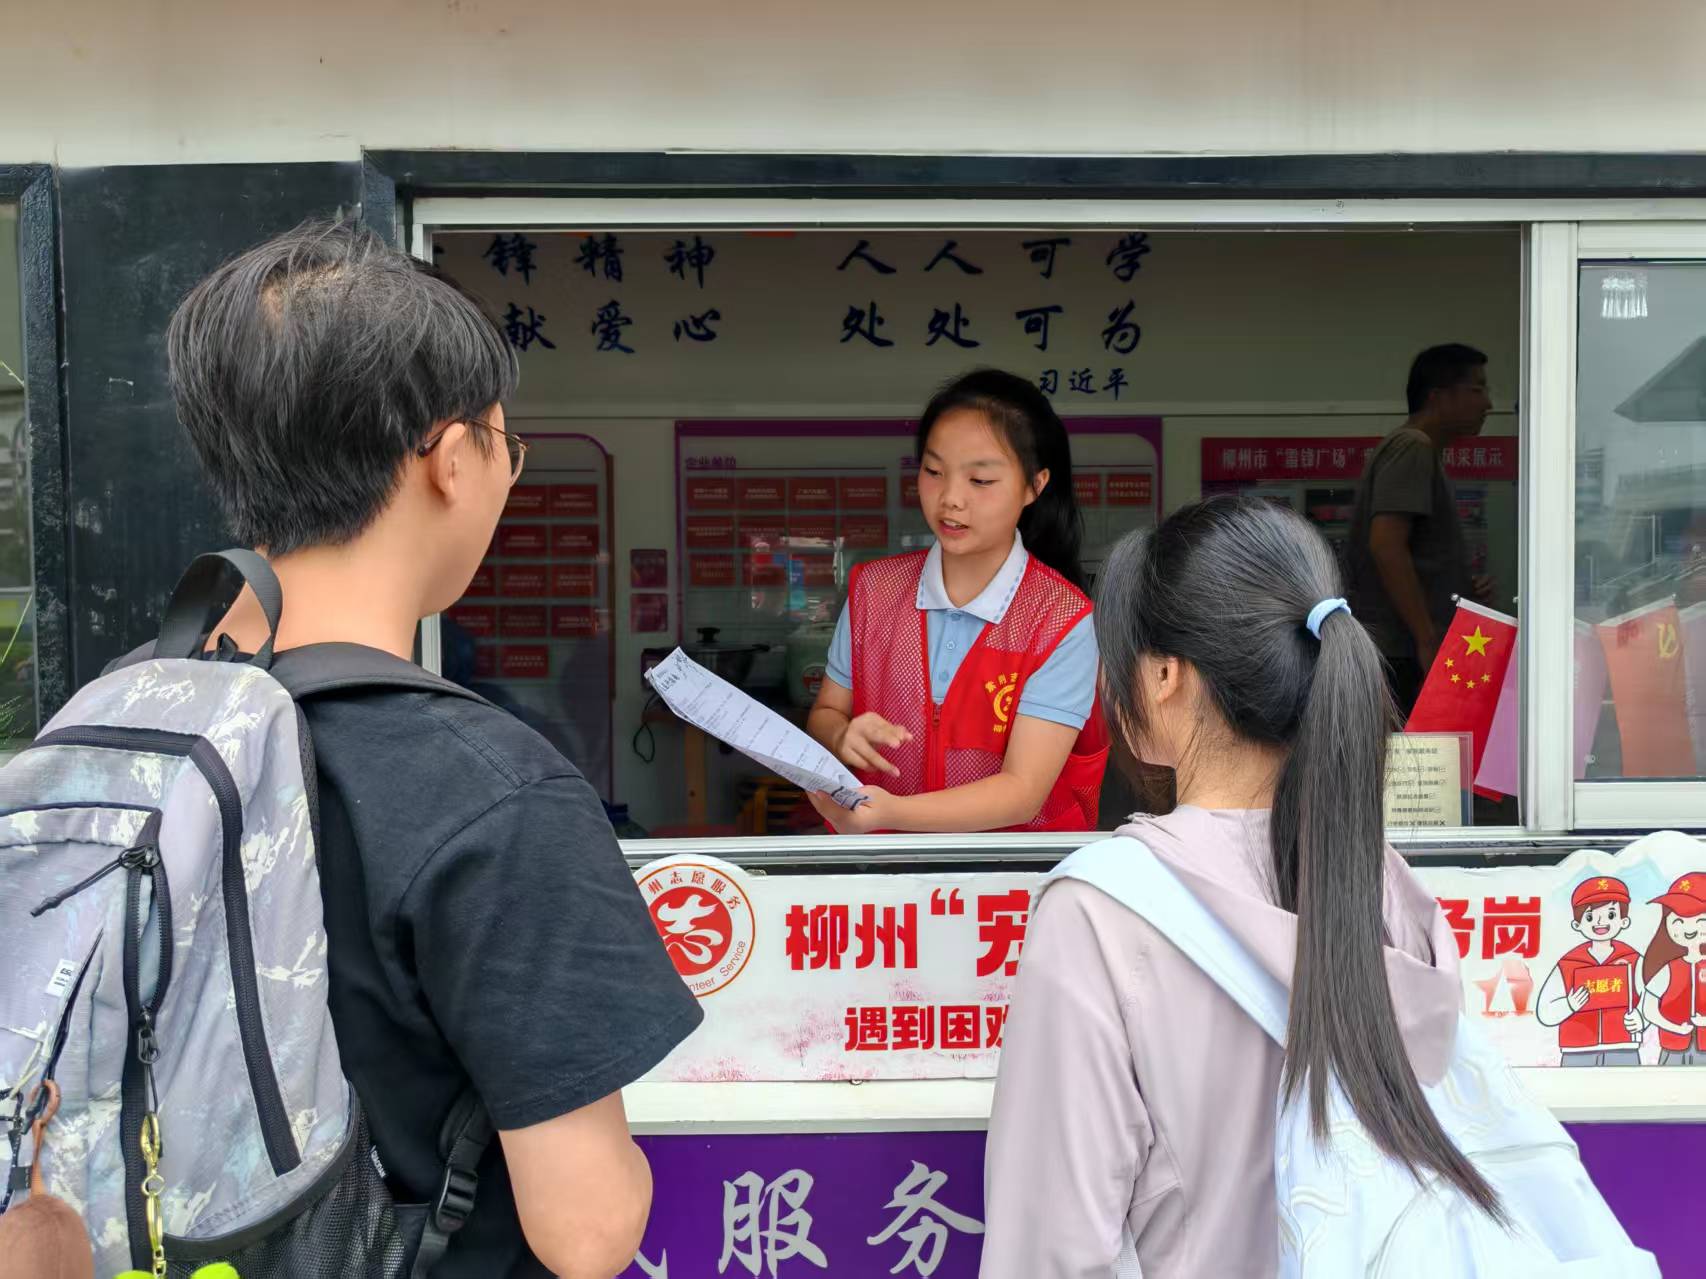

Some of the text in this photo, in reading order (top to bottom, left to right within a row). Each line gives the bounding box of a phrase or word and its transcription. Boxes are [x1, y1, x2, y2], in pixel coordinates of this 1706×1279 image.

[433, 231, 1152, 289] 锋精神 人人可学
[840, 299, 1141, 354] 处处可为
[1040, 367, 1129, 400] 习近平
[1442, 447, 1503, 468] 风采展示
[719, 940, 746, 977] Service
[1585, 977, 1623, 994] 志愿者
[636, 1159, 986, 1279] 服务
